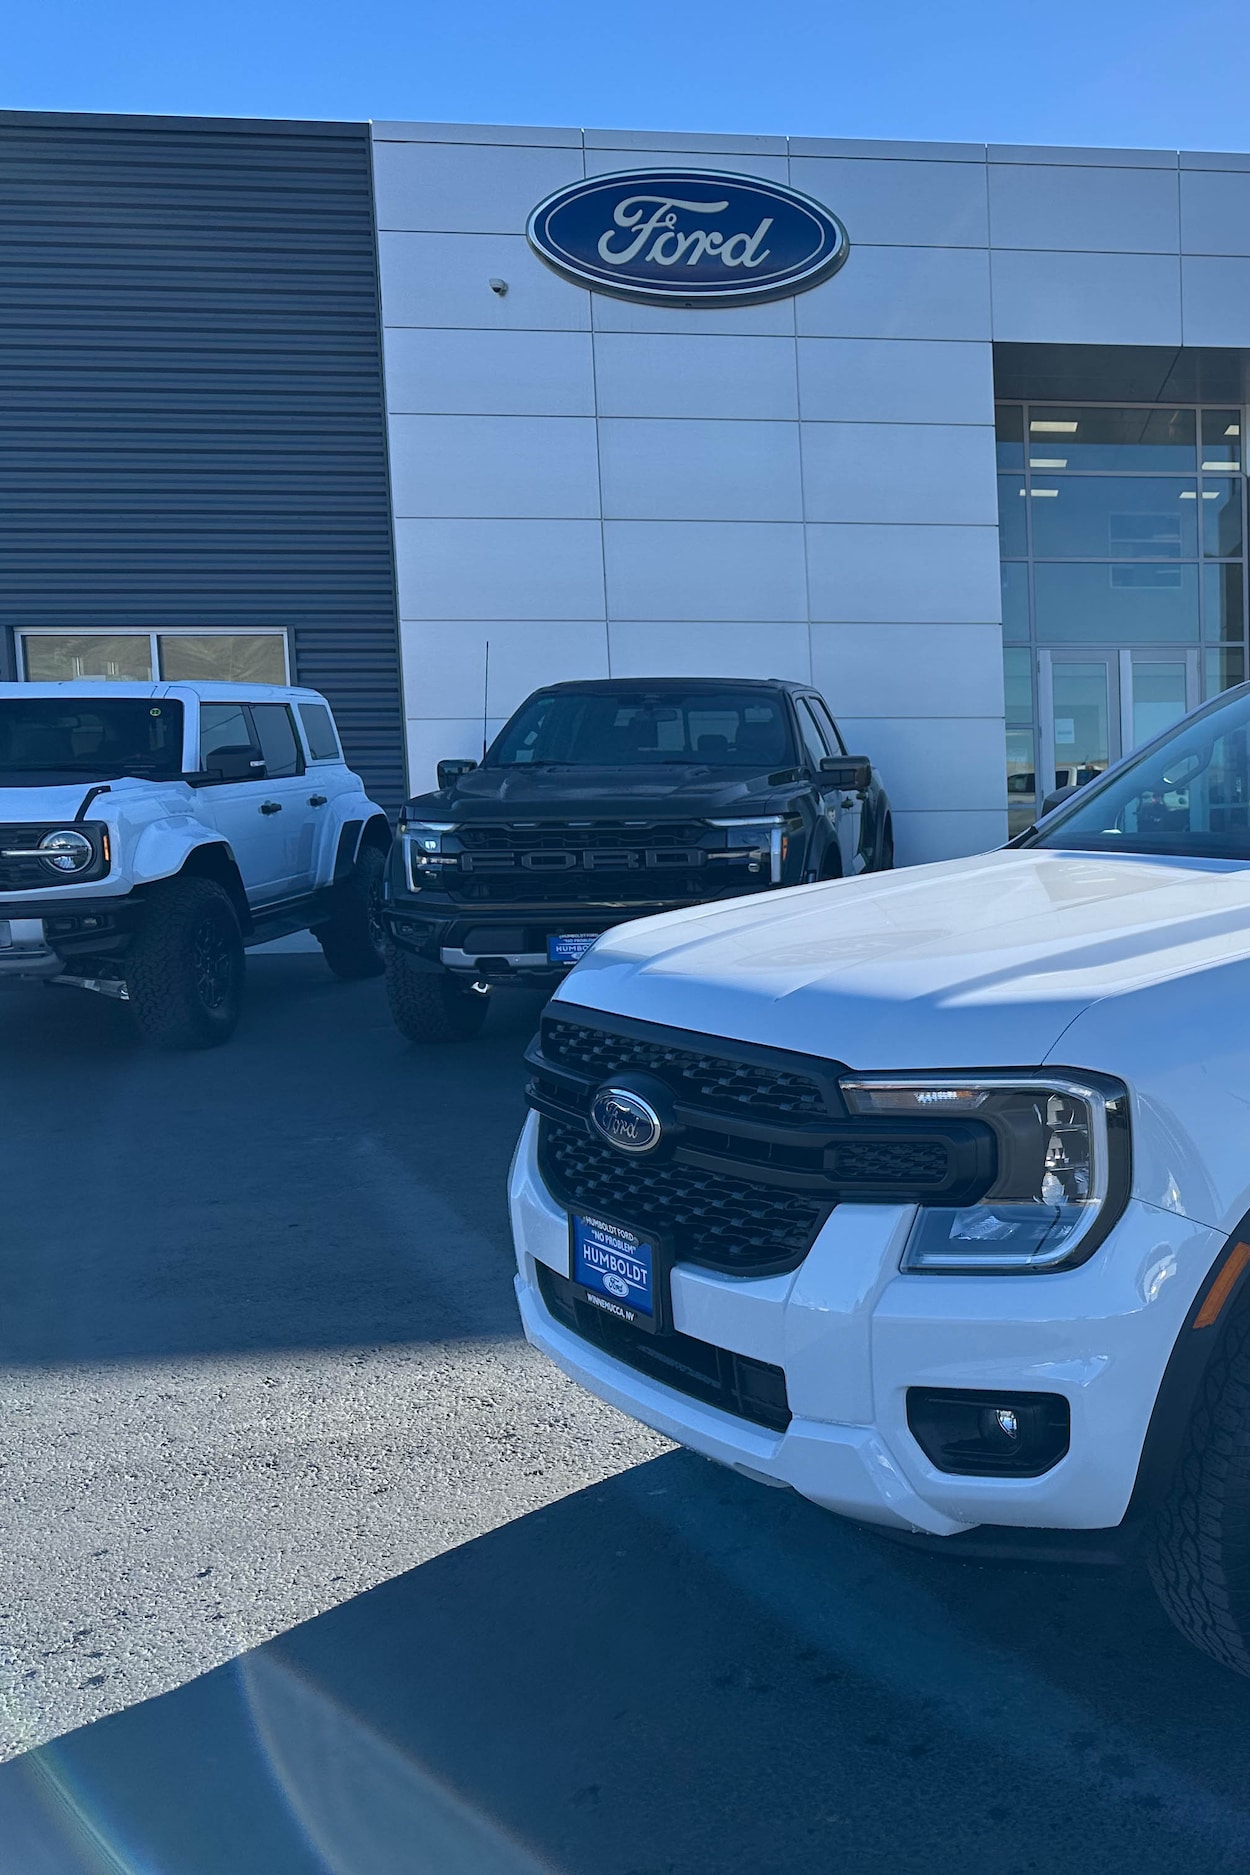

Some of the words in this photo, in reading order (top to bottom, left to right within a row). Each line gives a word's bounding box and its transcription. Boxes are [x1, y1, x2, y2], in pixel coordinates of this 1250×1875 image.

[598, 196, 773, 267] Ford
[461, 850, 706, 871] FORD
[603, 1100, 639, 1139] Ford
[585, 1215, 617, 1236] HUMBOLDT
[617, 1228, 634, 1241] FORD
[583, 1244, 648, 1284] HUMBOLDT
